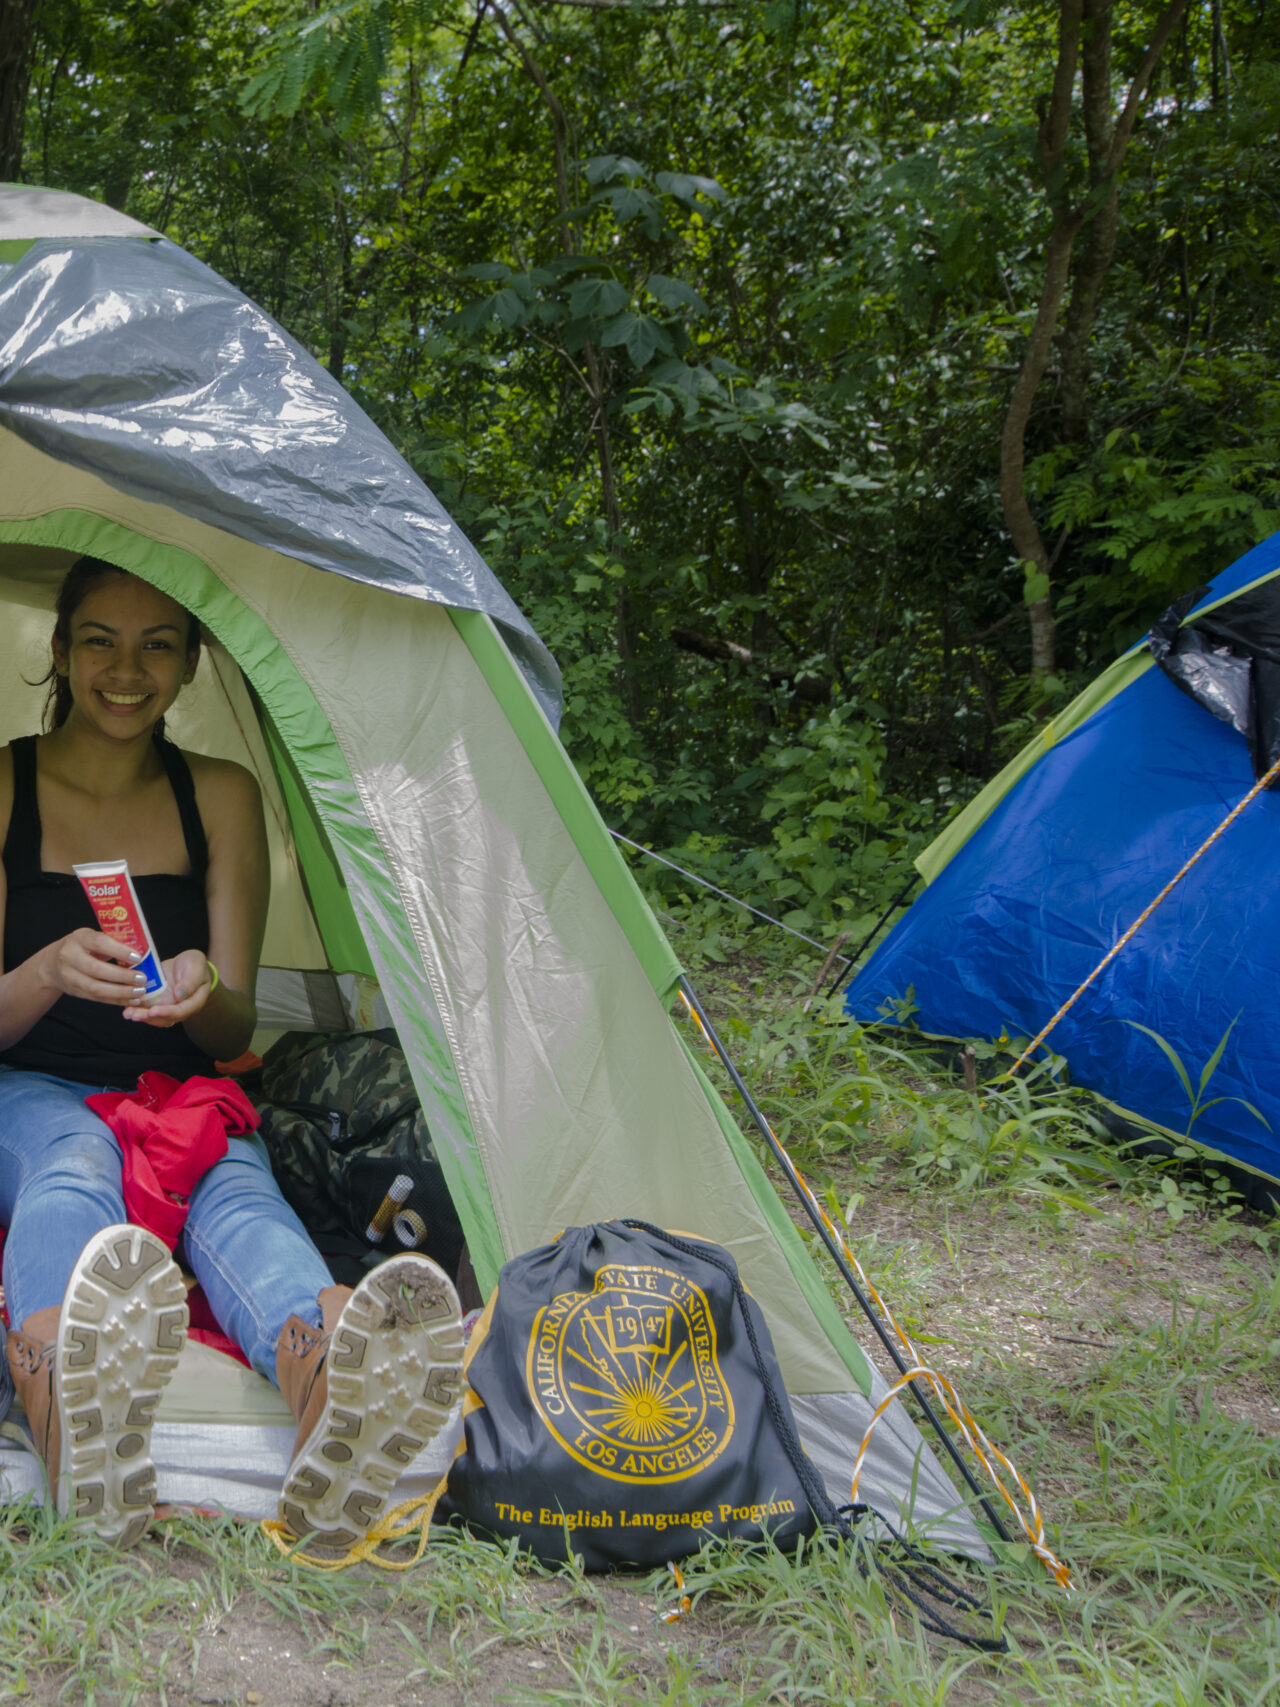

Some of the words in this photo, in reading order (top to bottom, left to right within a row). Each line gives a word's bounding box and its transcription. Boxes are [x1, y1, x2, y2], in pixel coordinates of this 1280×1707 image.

[88, 884, 121, 897] Solar
[670, 1281, 726, 1414] UNIVERSITY
[574, 1429, 618, 1467] LOS
[621, 1426, 718, 1474] ANGELES
[494, 1502, 533, 1523] The
[539, 1507, 614, 1531] English
[620, 1508, 714, 1531] Language
[718, 1498, 796, 1524] Program
